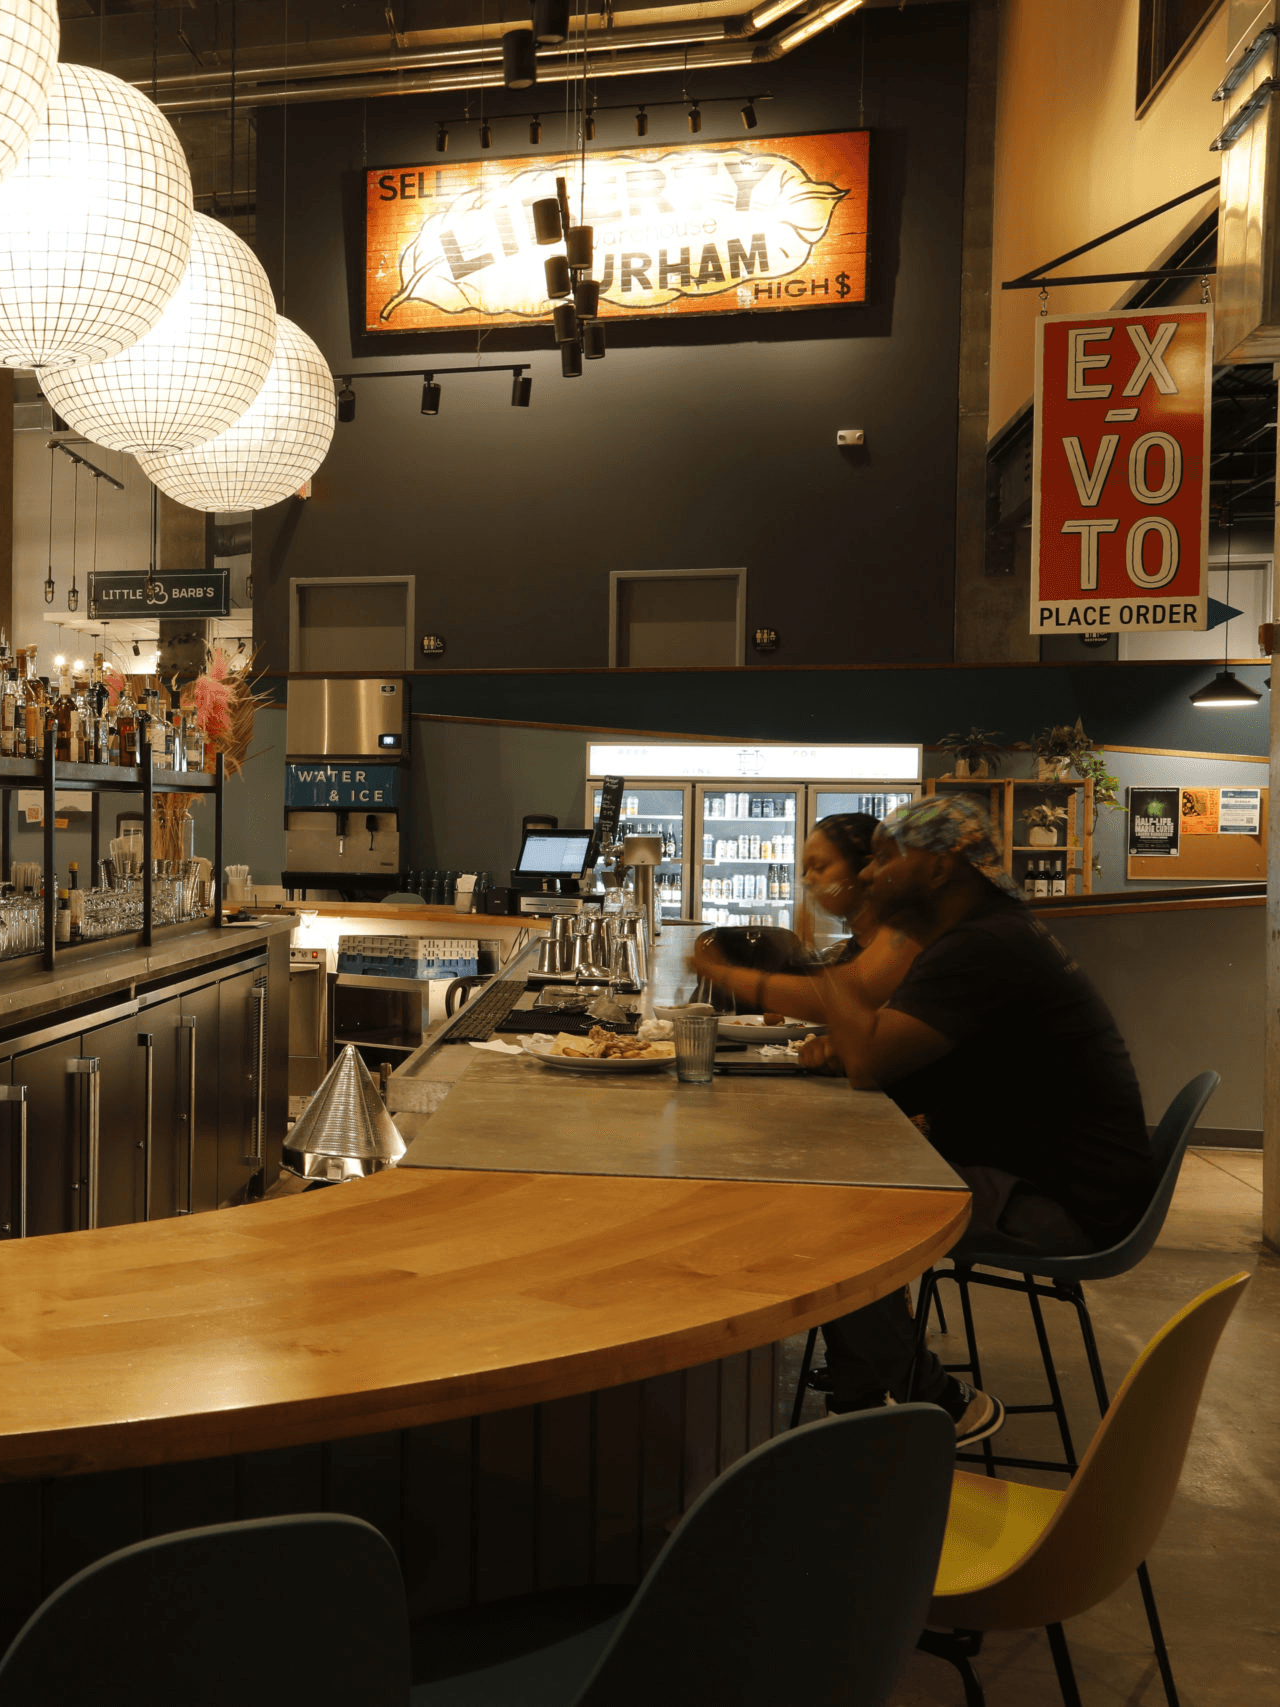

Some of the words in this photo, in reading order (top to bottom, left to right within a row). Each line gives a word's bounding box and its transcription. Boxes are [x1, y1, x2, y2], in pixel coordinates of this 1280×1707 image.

[438, 160, 774, 280] LIERTY
[590, 214, 718, 248] arehouse
[588, 232, 770, 296] URHAM
[1061, 431, 1184, 508] VO
[1060, 515, 1181, 591] TO
[102, 588, 143, 601] LITTLE
[172, 586, 215, 599] BARB'S
[1039, 605, 1111, 627] PLACE
[1119, 603, 1198, 625] ORDER
[298, 770, 366, 783] WATER
[329, 789, 340, 802] &
[350, 789, 384, 802] ICE
